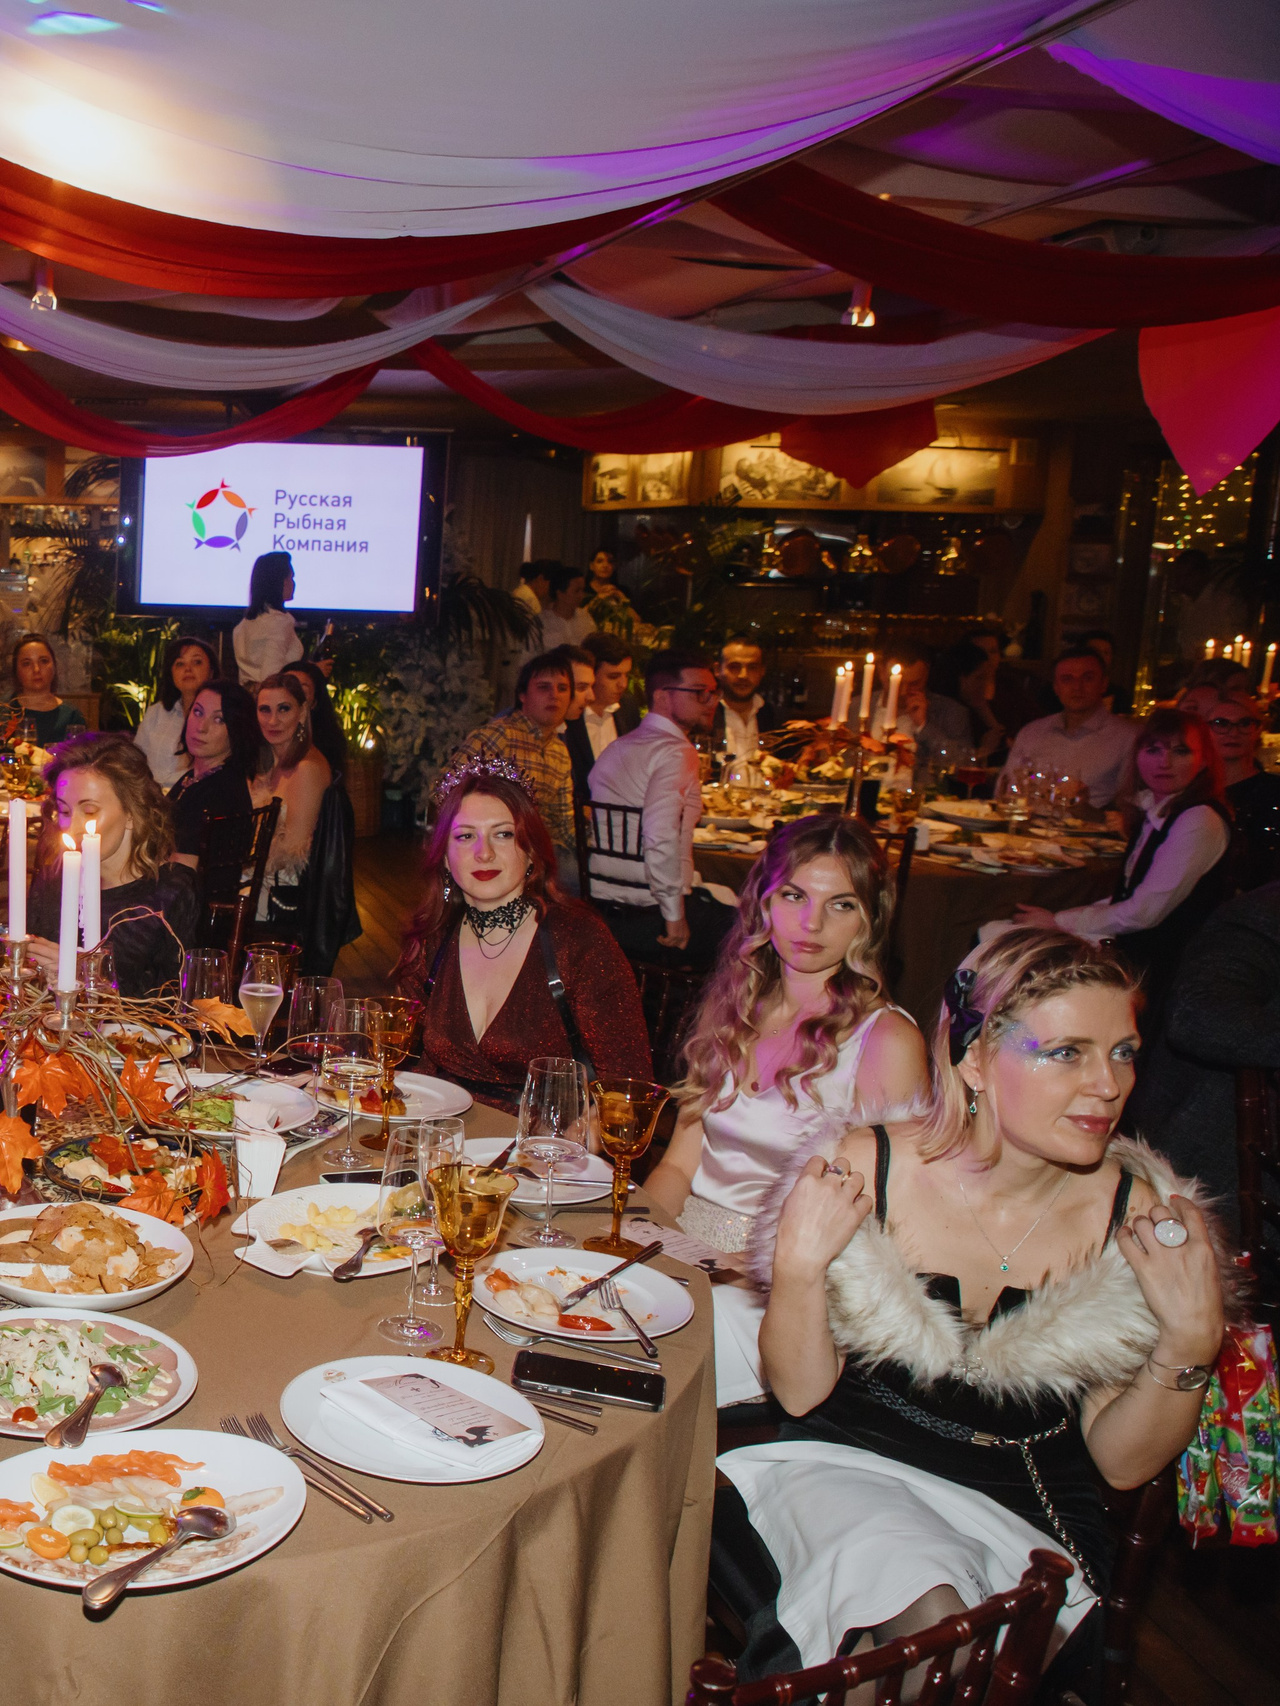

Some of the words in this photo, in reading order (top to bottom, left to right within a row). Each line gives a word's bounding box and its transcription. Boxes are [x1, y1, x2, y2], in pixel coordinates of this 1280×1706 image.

[275, 489, 353, 510] Русская
[274, 512, 347, 531] Рыбная
[272, 534, 369, 553] Компания
